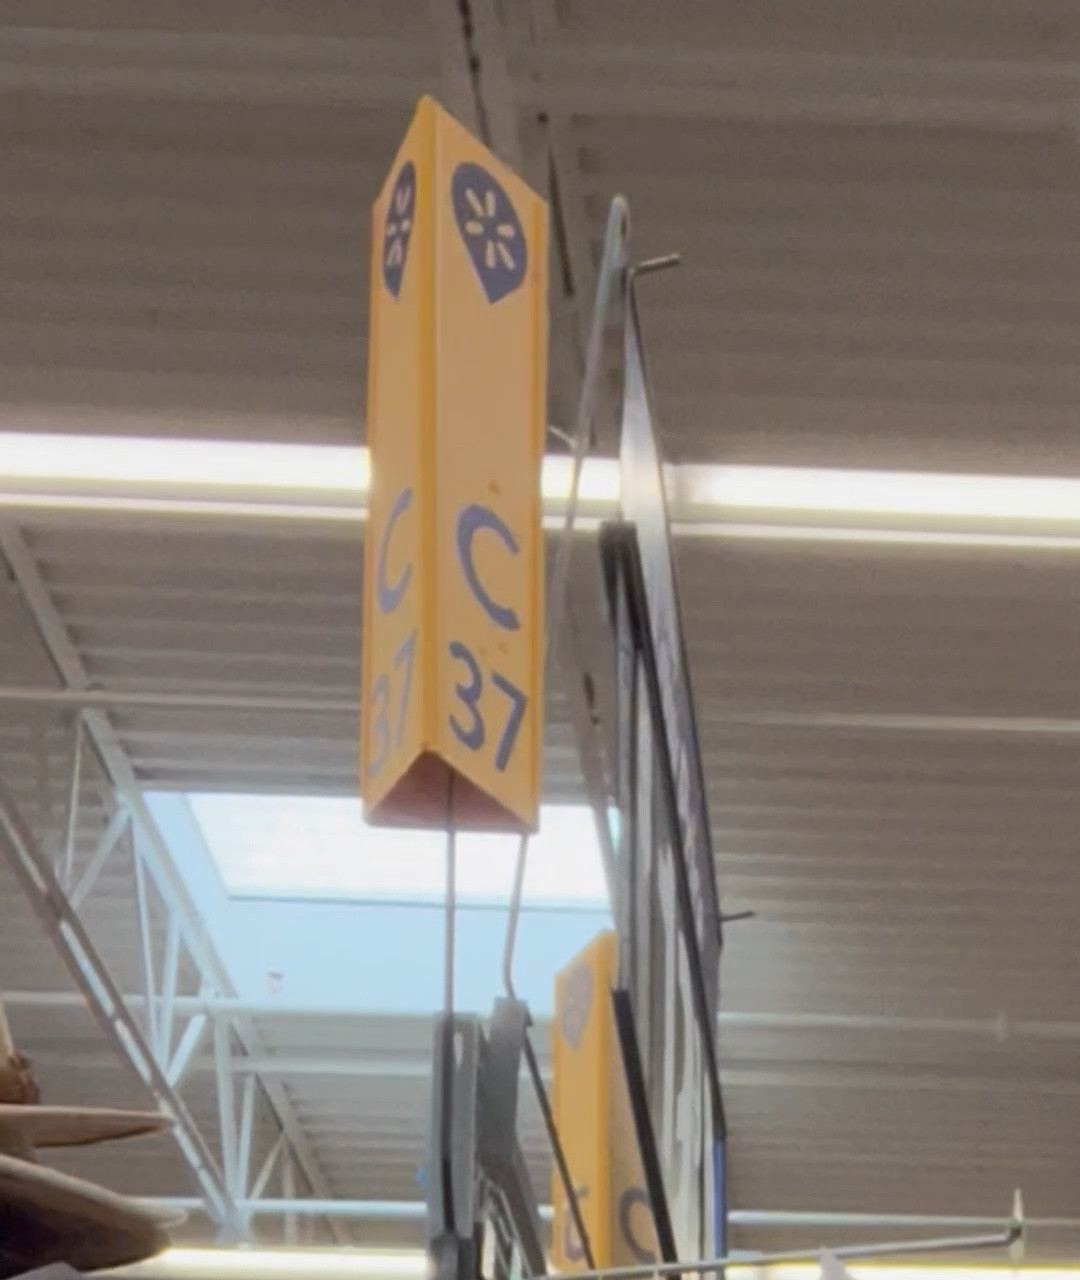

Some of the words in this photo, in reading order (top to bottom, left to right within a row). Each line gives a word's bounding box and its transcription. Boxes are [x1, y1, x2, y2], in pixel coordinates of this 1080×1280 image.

[377, 487, 412, 614] C
[455, 504, 522, 631] C
[367, 630, 418, 778] 37
[447, 640, 528, 772] 37
